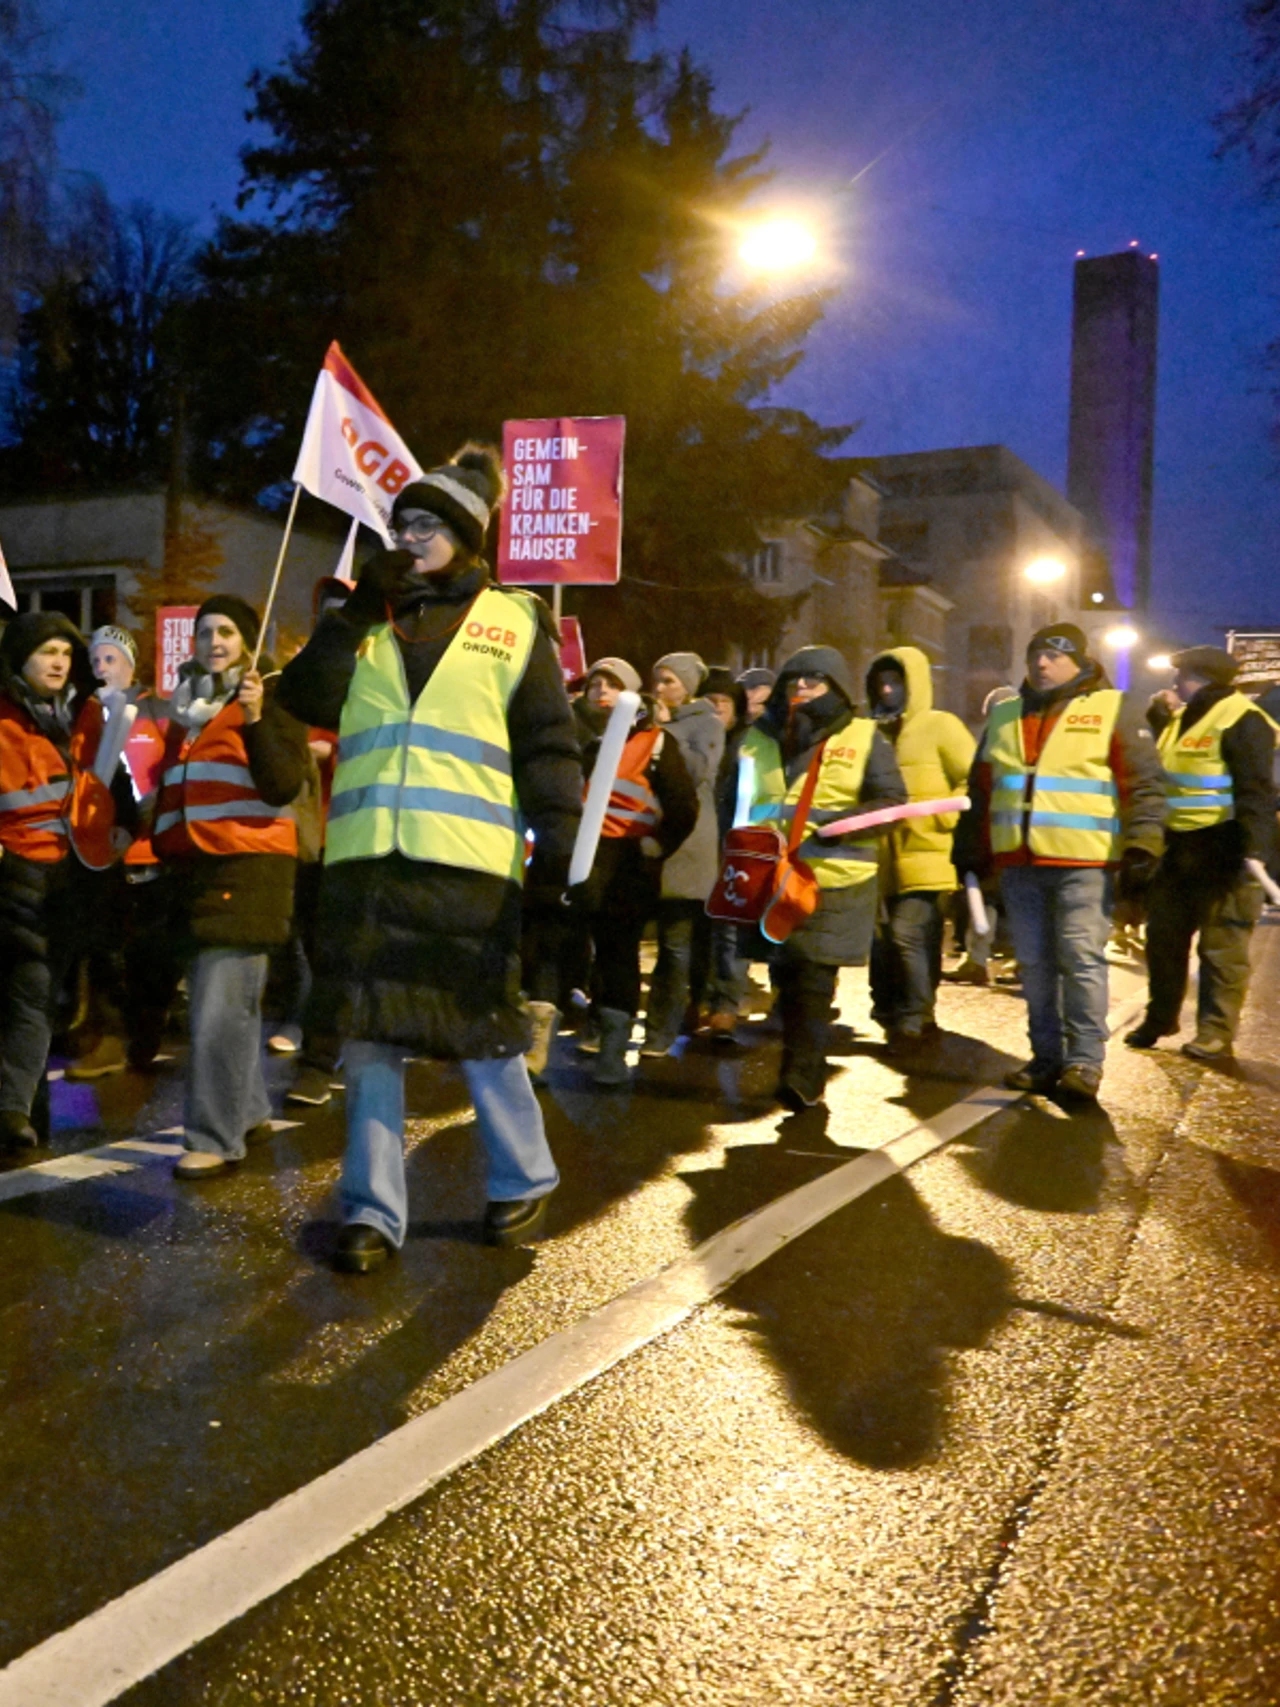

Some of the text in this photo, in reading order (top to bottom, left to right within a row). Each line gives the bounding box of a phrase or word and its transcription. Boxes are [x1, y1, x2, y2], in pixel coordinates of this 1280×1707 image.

[513, 437, 588, 461] GEMEIN-
[512, 463, 552, 486] SAM
[511, 486, 578, 511] FÜR DIE
[510, 512, 600, 536] KRANKEN-
[509, 533, 577, 561] HÄUSER
[462, 641, 513, 662] ORDNER
